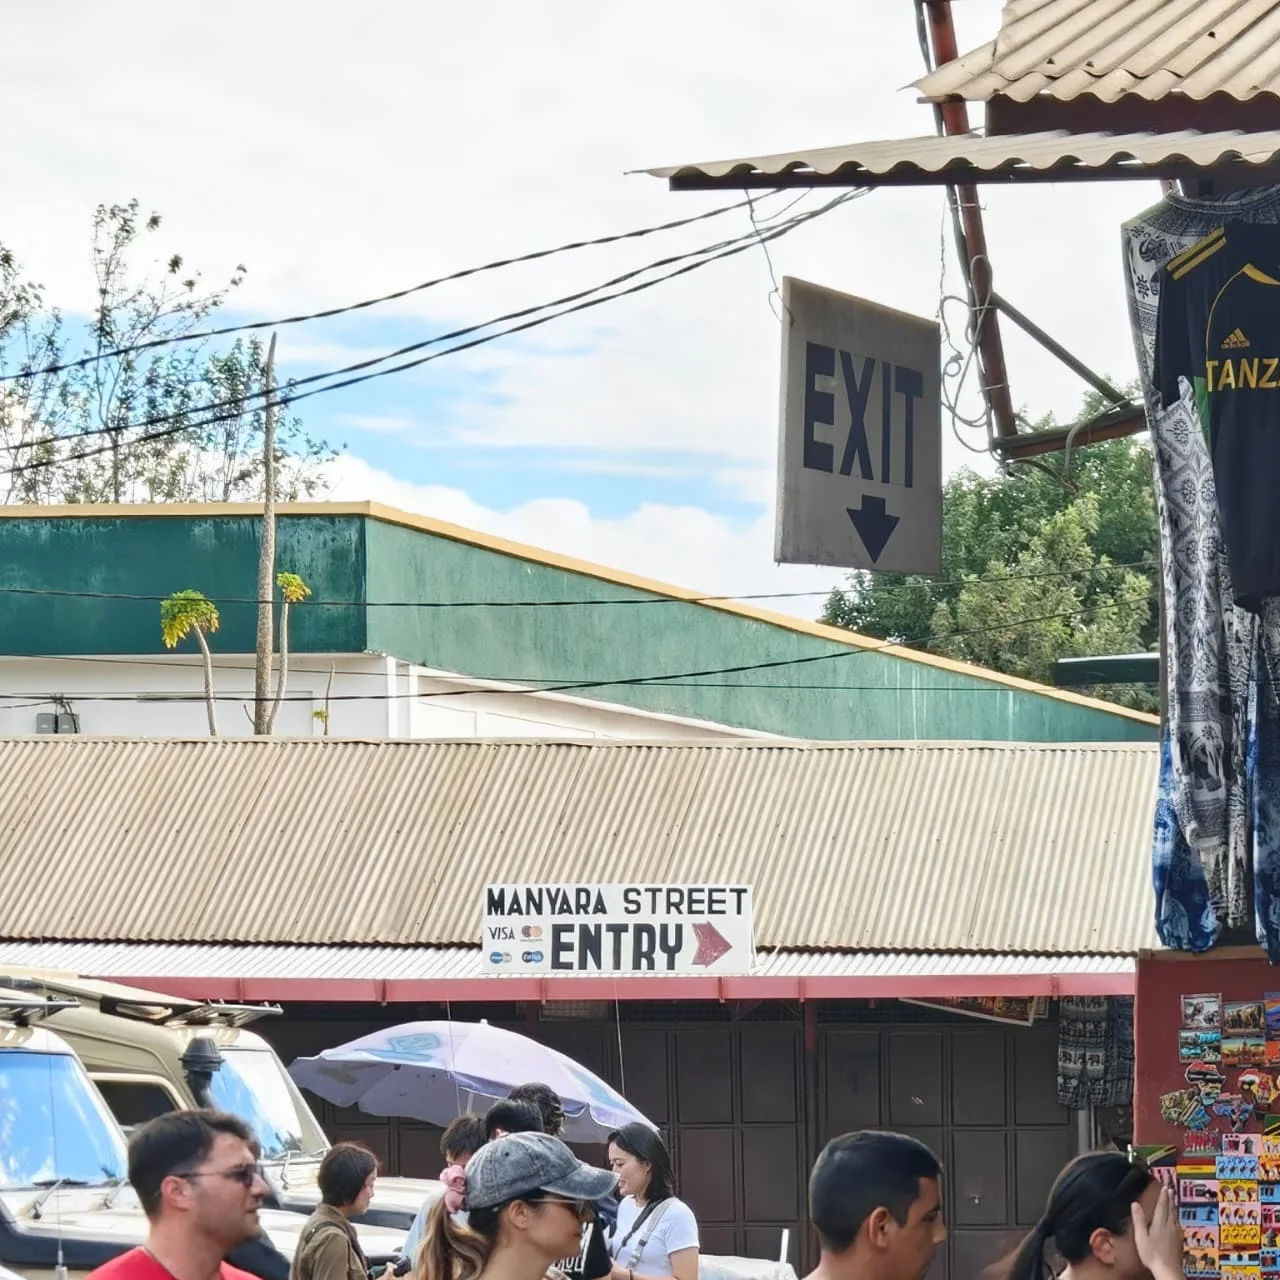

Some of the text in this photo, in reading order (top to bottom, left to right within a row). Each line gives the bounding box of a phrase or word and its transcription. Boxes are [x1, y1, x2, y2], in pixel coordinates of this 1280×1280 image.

[803, 341, 924, 489] EXIT
[486, 887, 748, 917] MANYARA STREET
[487, 926, 516, 941] VISA
[550, 922, 684, 971] ENTRY
